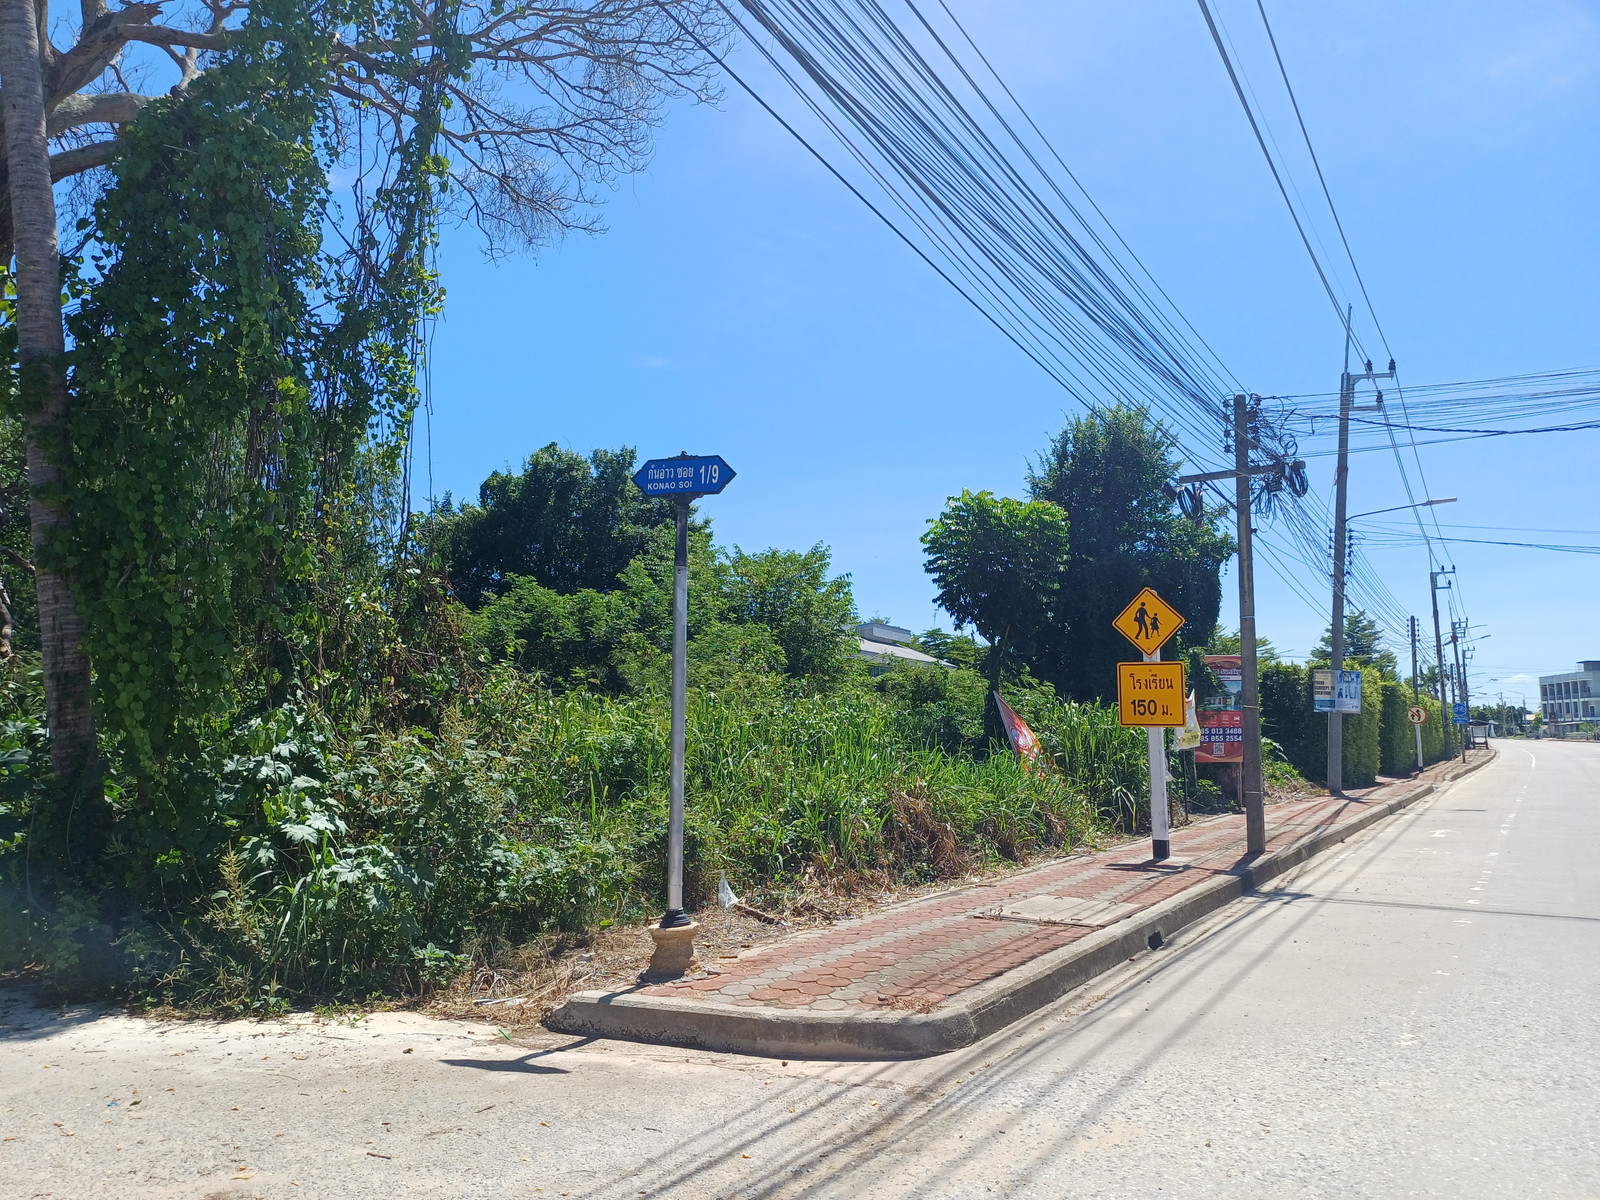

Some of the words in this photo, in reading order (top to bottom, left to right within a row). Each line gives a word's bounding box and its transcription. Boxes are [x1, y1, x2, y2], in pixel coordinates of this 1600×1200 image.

[676, 466, 694, 478] ซอย
[700, 464, 719, 484] 1/9
[647, 481, 676, 490] KONAO
[678, 480, 693, 489] SOI
[1129, 673, 1174, 690] โรงเรียน
[1130, 699, 1158, 716] 150
[1161, 704, 1173, 716] ม.
